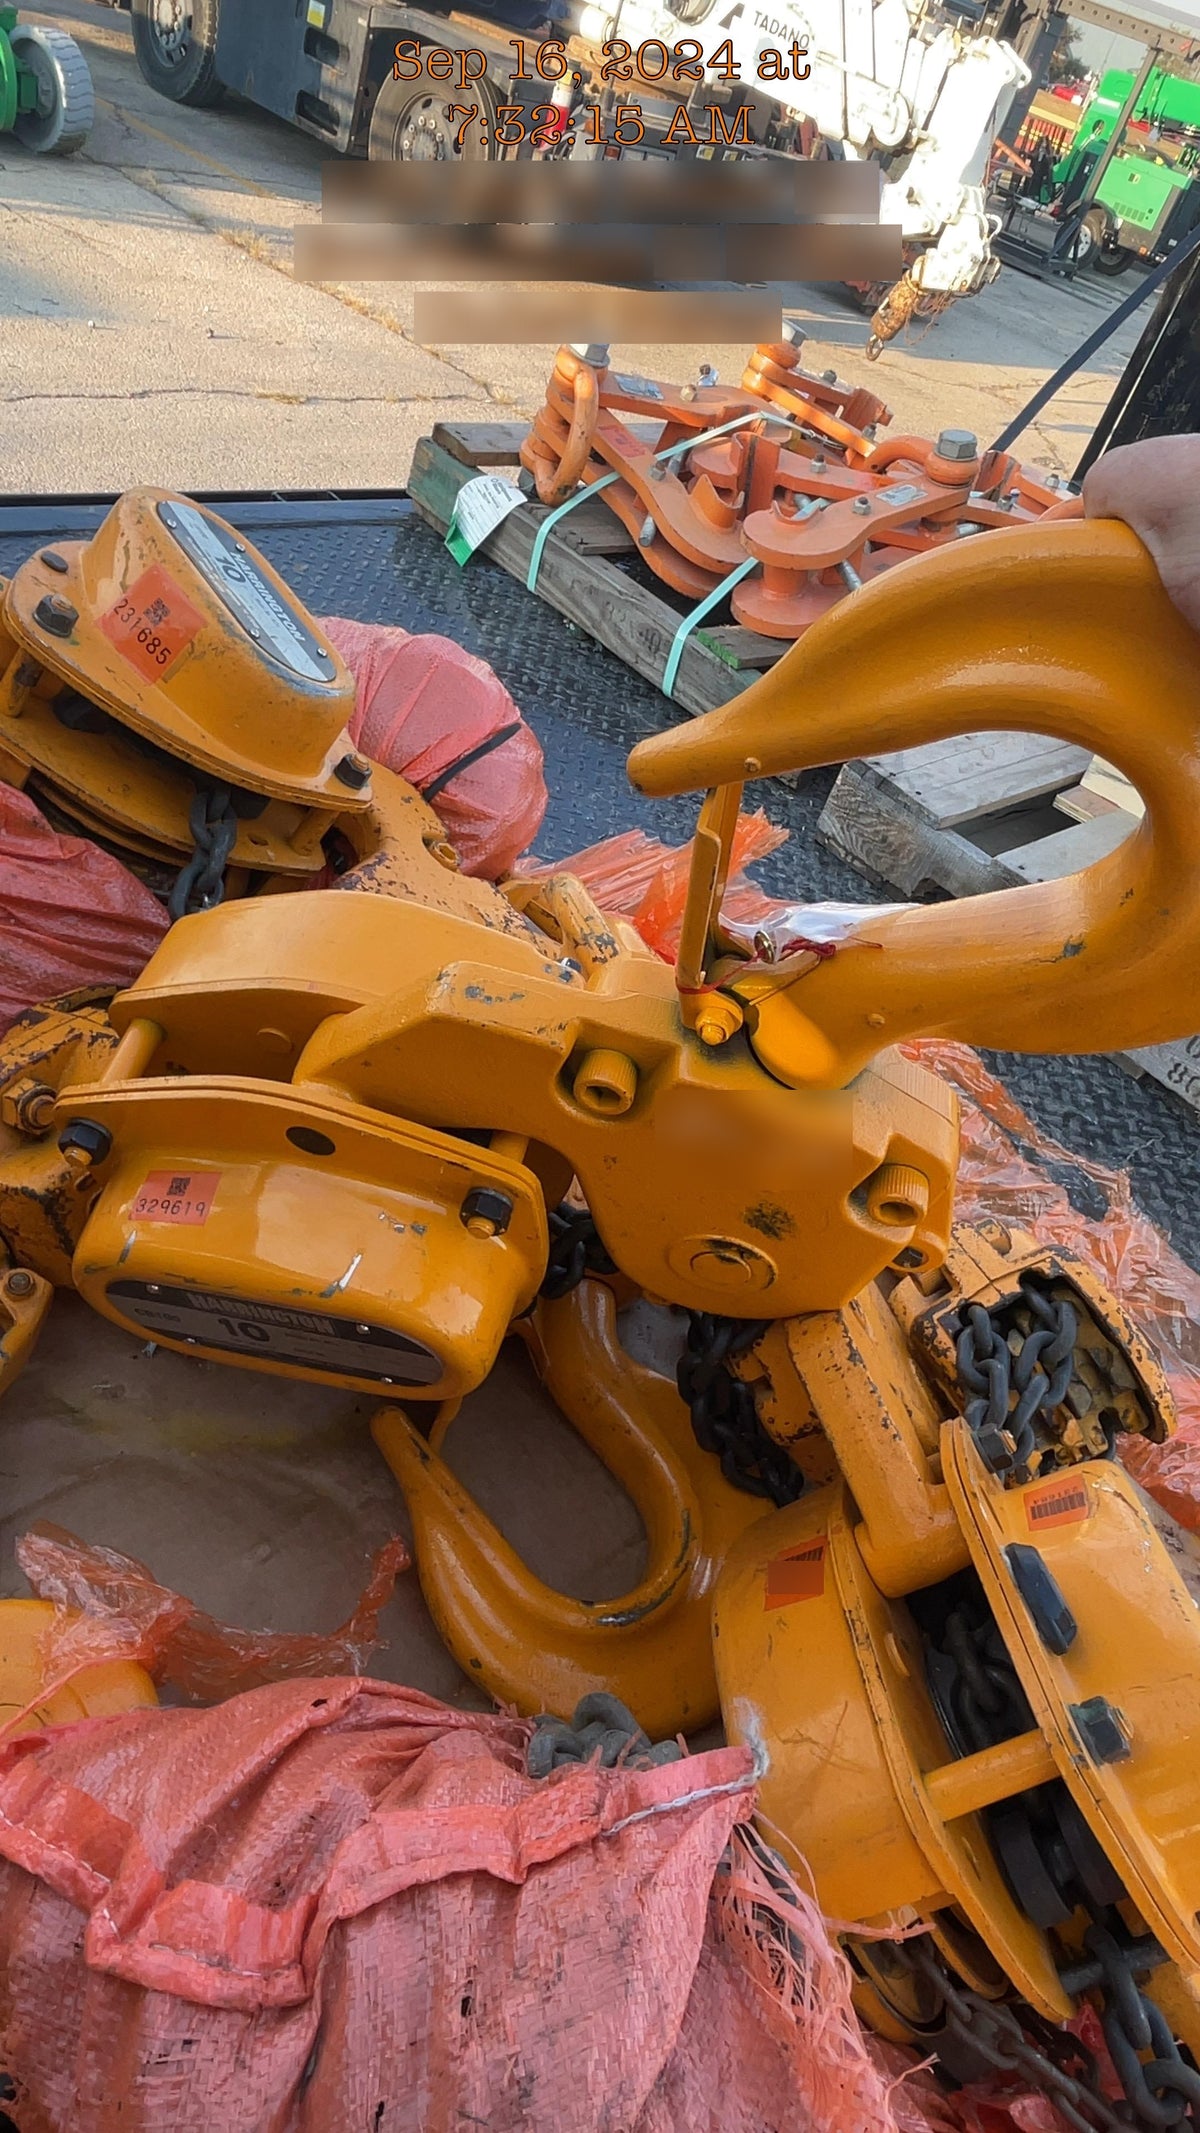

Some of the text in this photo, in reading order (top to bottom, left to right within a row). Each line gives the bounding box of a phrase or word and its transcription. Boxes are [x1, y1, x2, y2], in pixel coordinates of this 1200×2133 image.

[753, 10, 811, 50] TADANO
[214, 553, 247, 584] 10
[230, 551, 306, 643] HARRINGTON
[113, 598, 172, 665] 231685
[135, 1198, 206, 1217] 329619
[186, 1292, 336, 1336] HARRINGTON
[217, 1317, 271, 1342] 10
